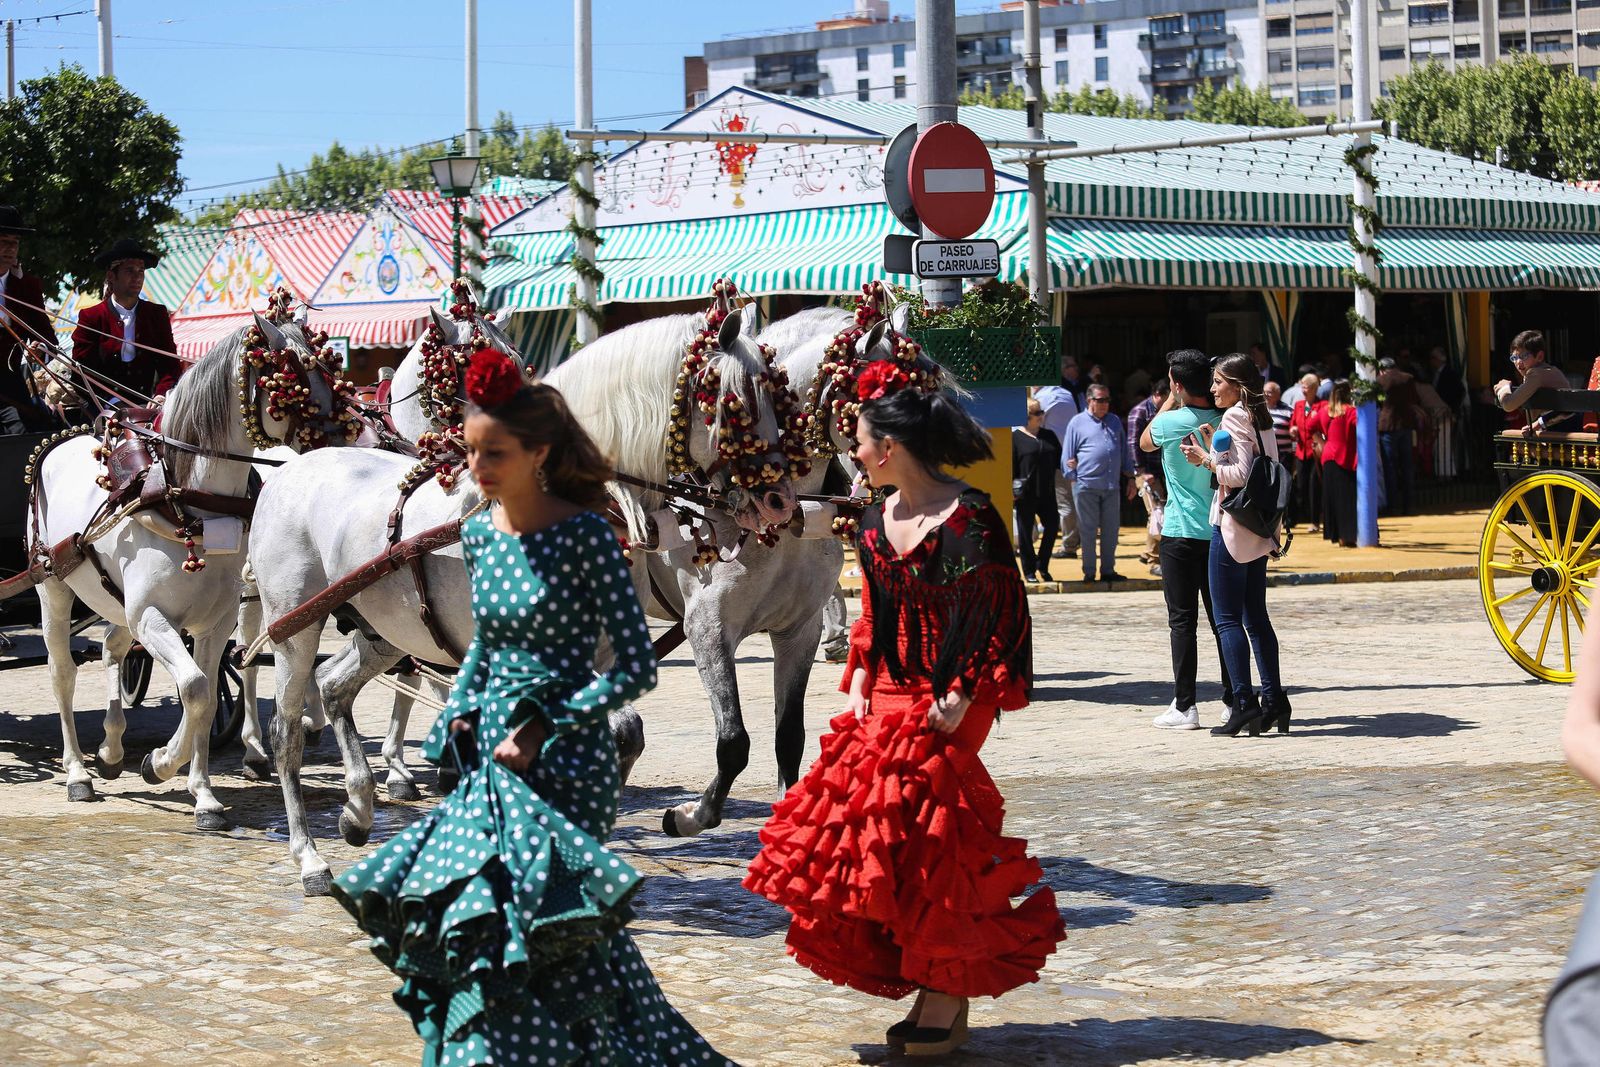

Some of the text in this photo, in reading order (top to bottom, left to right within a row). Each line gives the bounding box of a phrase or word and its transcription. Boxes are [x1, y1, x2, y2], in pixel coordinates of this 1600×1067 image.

[940, 245, 974, 257] PASEO
[920, 259, 998, 272] DE CARRUAJES
